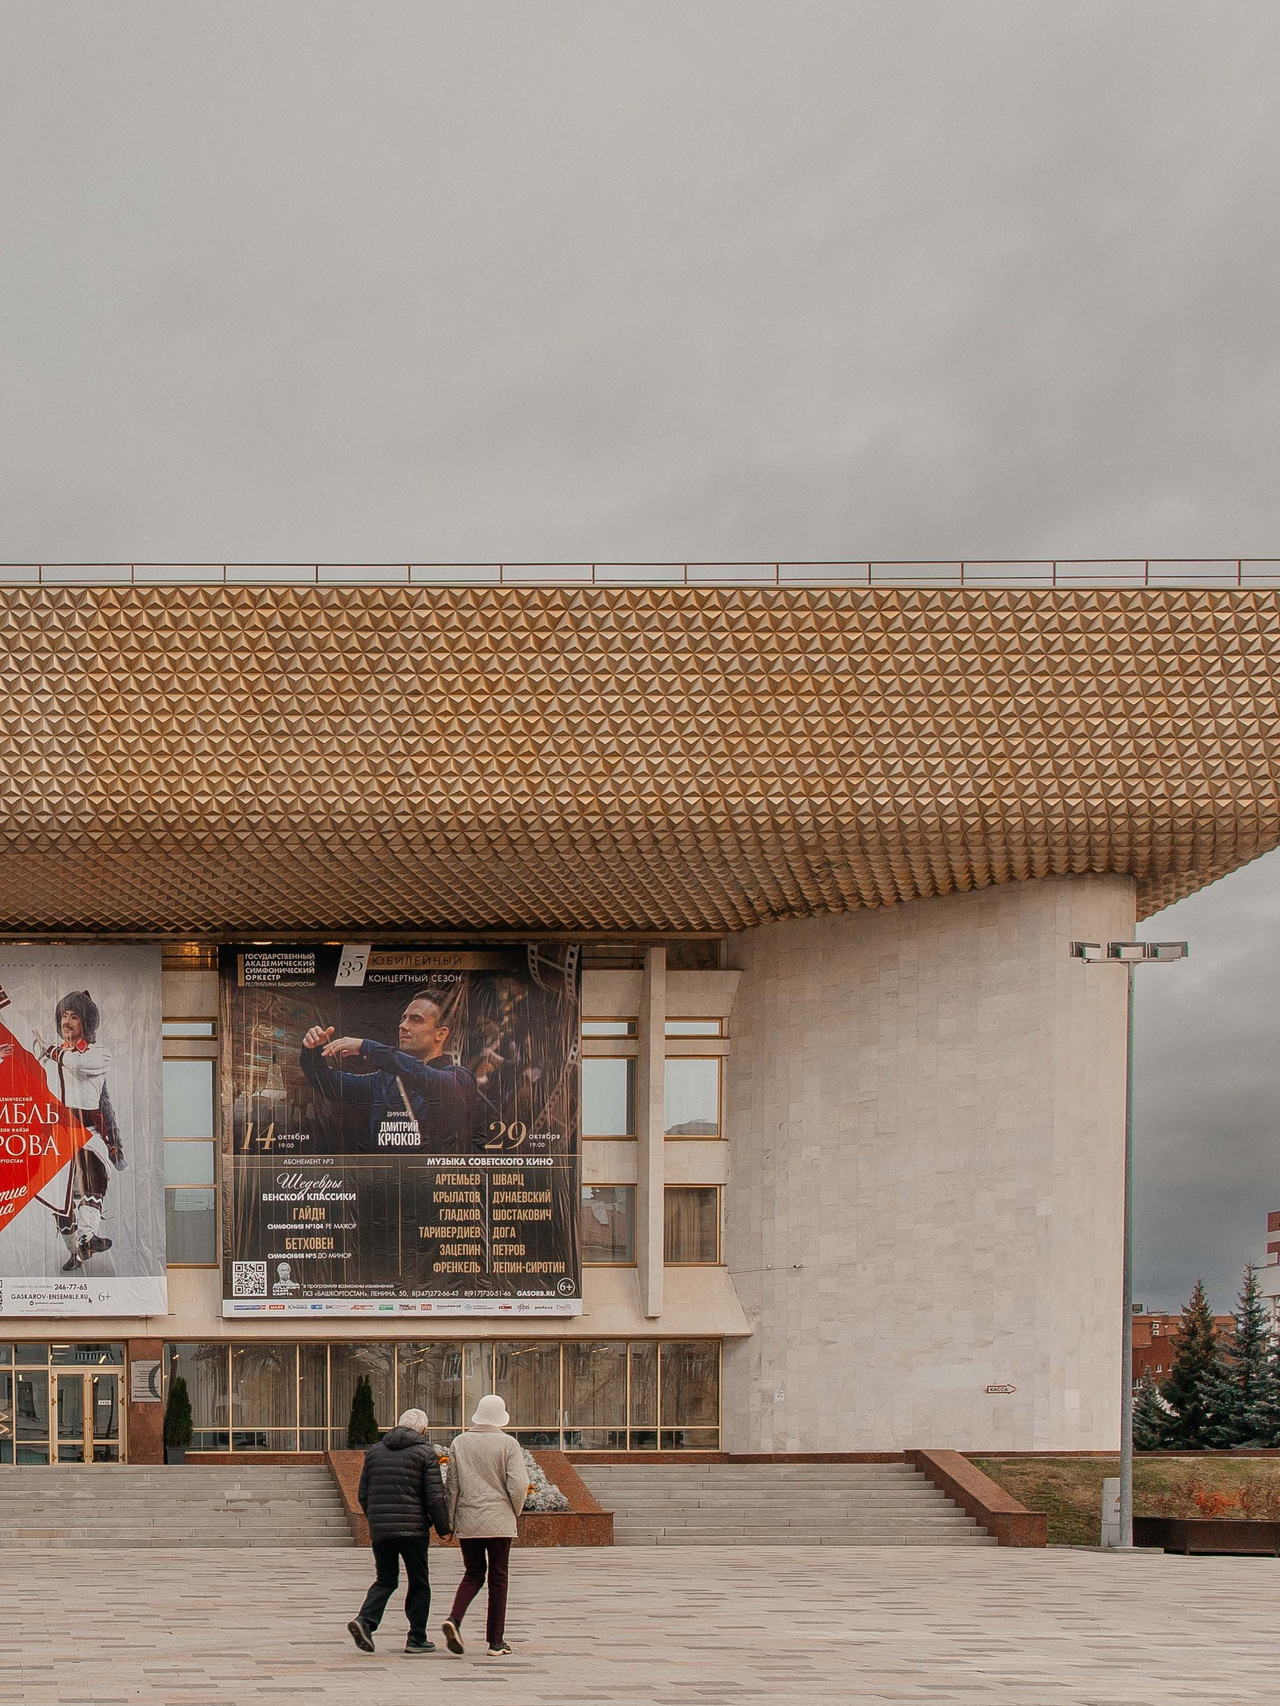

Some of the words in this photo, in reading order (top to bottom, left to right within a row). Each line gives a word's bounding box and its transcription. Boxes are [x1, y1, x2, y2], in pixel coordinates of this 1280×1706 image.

[245, 952, 315, 960] ГОСУДАРСТВЕННЫЙ
[339, 955, 365, 978] 35
[372, 954, 463, 966] ЮБИЛЕЙНЫЙ
[368, 973, 429, 983] КОНЦЕРТНЫЙ
[431, 974, 462, 983] СЕЗОН
[380, 1120, 419, 1133] ДМИТРИЙ
[239, 1122, 276, 1150] 14
[277, 1132, 310, 1141] октября
[378, 1132, 421, 1146] КРЮКОВ
[484, 1120, 527, 1150] 29
[528, 1132, 561, 1140] октября
[426, 1158, 466, 1166] МУЗЫКА
[468, 1157, 524, 1166] СОВЕТСКОГО
[526, 1157, 554, 1166] КИНО
[276, 1172, 343, 1197] Шедевры
[435, 1173, 481, 1186] АРТЕМЬЕВ
[492, 1173, 525, 1187] ШВАРЦ
[262, 1193, 305, 1201] ВЕНСКОЙ
[307, 1193, 357, 1201] КЛАССИКИ
[433, 1191, 481, 1203] КРЫЛАТОВ
[492, 1189, 551, 1204] ДУНАЕВСКИЙ
[293, 1205, 326, 1221] ГАЙДН
[439, 1209, 481, 1221] ГЛАДКОВ
[492, 1209, 552, 1221] ШОСТАКОВИЧ
[419, 1226, 481, 1239] ТАРИВЕРДИЕВ
[492, 1226, 516, 1239] ДОГА
[285, 1237, 334, 1250] БЕТХОВЕН
[439, 1244, 481, 1256] ЗАЦЕПИН
[492, 1244, 526, 1256] ПЕТРОВ
[433, 1261, 481, 1273] ФРЕНКЕЛЬ
[492, 1261, 566, 1273] ЛЕПИН-СИРОТИН
[560, 1281, 573, 1291] 6+
[98, 1291, 112, 1302] 6+
[370, 1290, 397, 1298] ЛЕНИНА,
